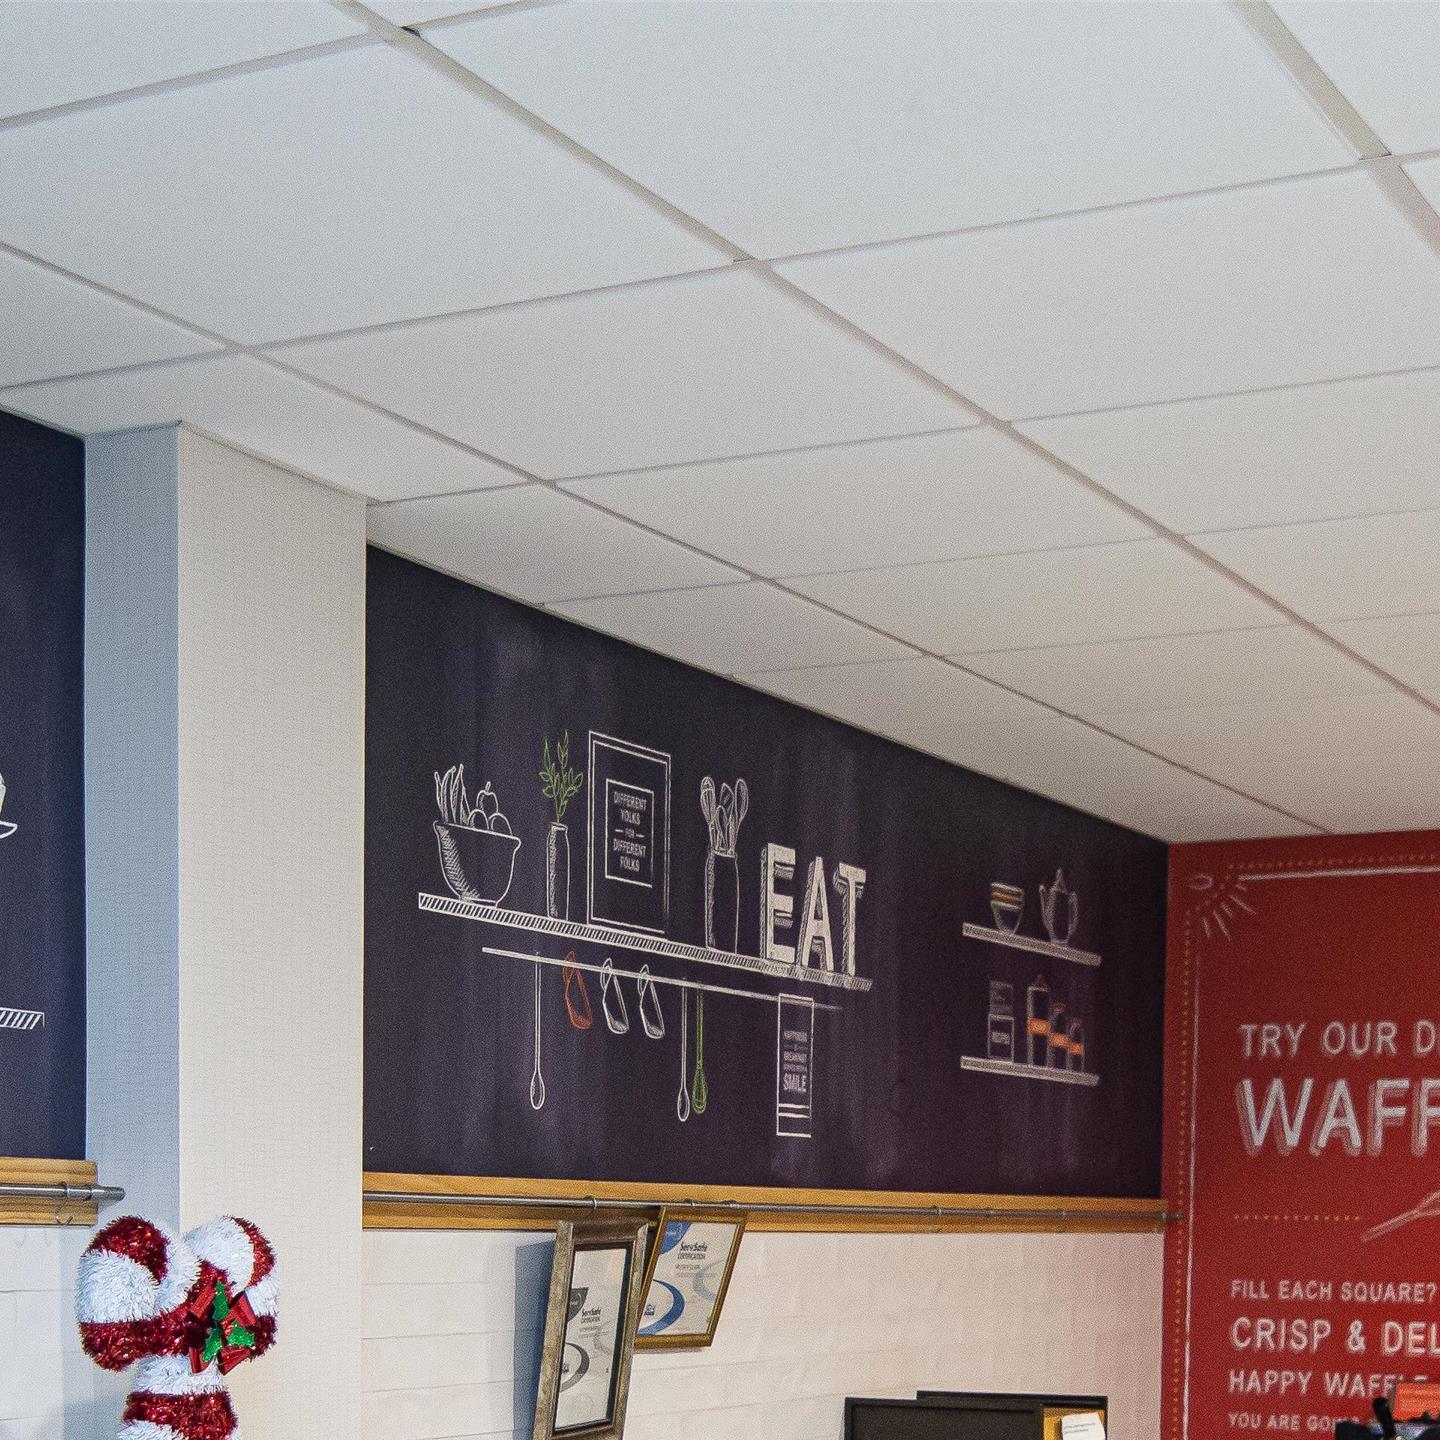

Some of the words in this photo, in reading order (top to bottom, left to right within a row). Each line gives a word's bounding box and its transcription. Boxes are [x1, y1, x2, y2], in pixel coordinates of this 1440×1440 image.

[613, 791, 647, 812] DIFFERENT
[613, 838, 647, 857] DIFFERENT
[620, 855, 640, 872] FOLKS
[761, 843, 867, 975] EAT
[1239, 1022, 1307, 1057] TRY
[1322, 1020, 1398, 1057] OUR
[1231, 1280, 1270, 1299] FILL
[1278, 1280, 1333, 1300] EACH
[1341, 1281, 1438, 1303] SQUARE?
[1231, 1316, 1332, 1353] CRISP
[1347, 1320, 1366, 1354] &
[1227, 1369, 1312, 1396] HAPPY
[1228, 1412, 1261, 1428] YOU
[1267, 1414, 1300, 1431] ARE
